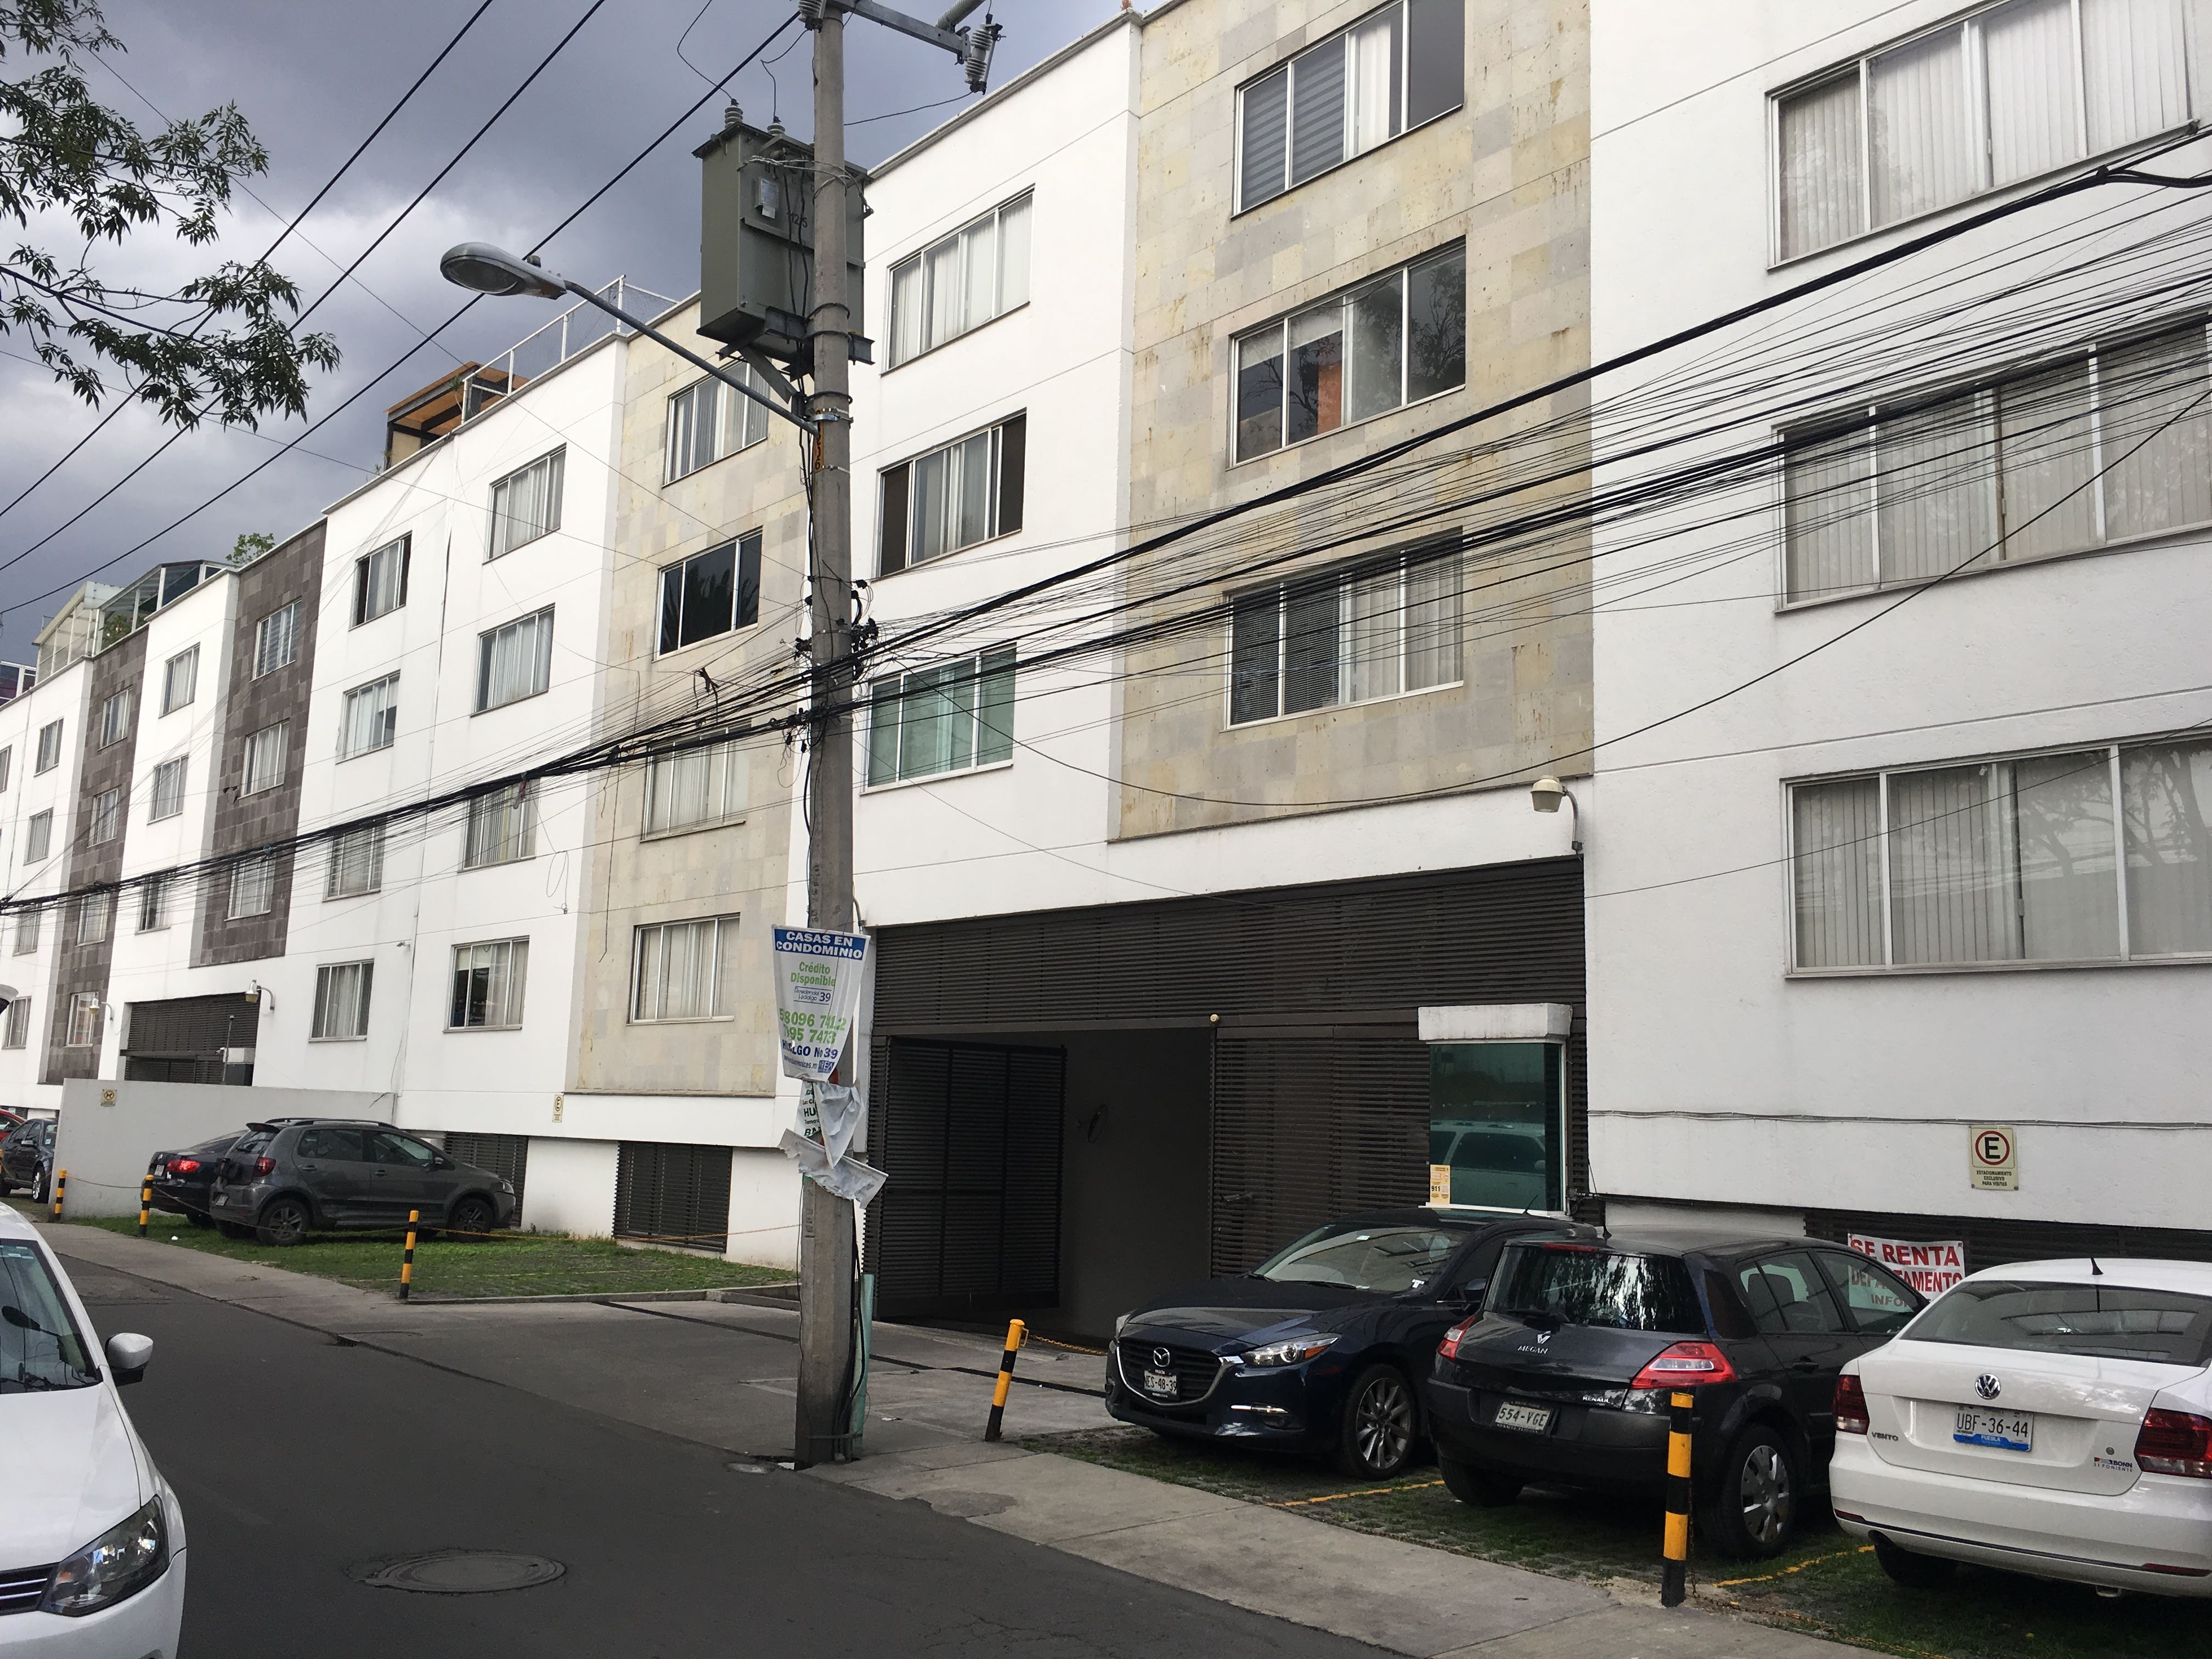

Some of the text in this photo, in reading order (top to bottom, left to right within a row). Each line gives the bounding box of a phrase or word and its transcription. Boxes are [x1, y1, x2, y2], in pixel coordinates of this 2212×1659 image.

[786, 932, 853, 947] CASAS EN
[776, 941, 862, 958] CONDOMINIO
[799, 962, 831, 974] Crédito
[791, 973, 836, 986] Disponible
[819, 992, 831, 1002] 39
[824, 1047, 838, 1059] 39
[1984, 1137, 2001, 1159] E
[1882, 1244, 1961, 1267] RENTA
[1499, 1408, 1548, 1426] 554-VGE
[1957, 1413, 2029, 1438] UBF-36-44
[2102, 1464, 2133, 1472] PONIENTE
[2113, 1460, 2133, 1468] BONN
